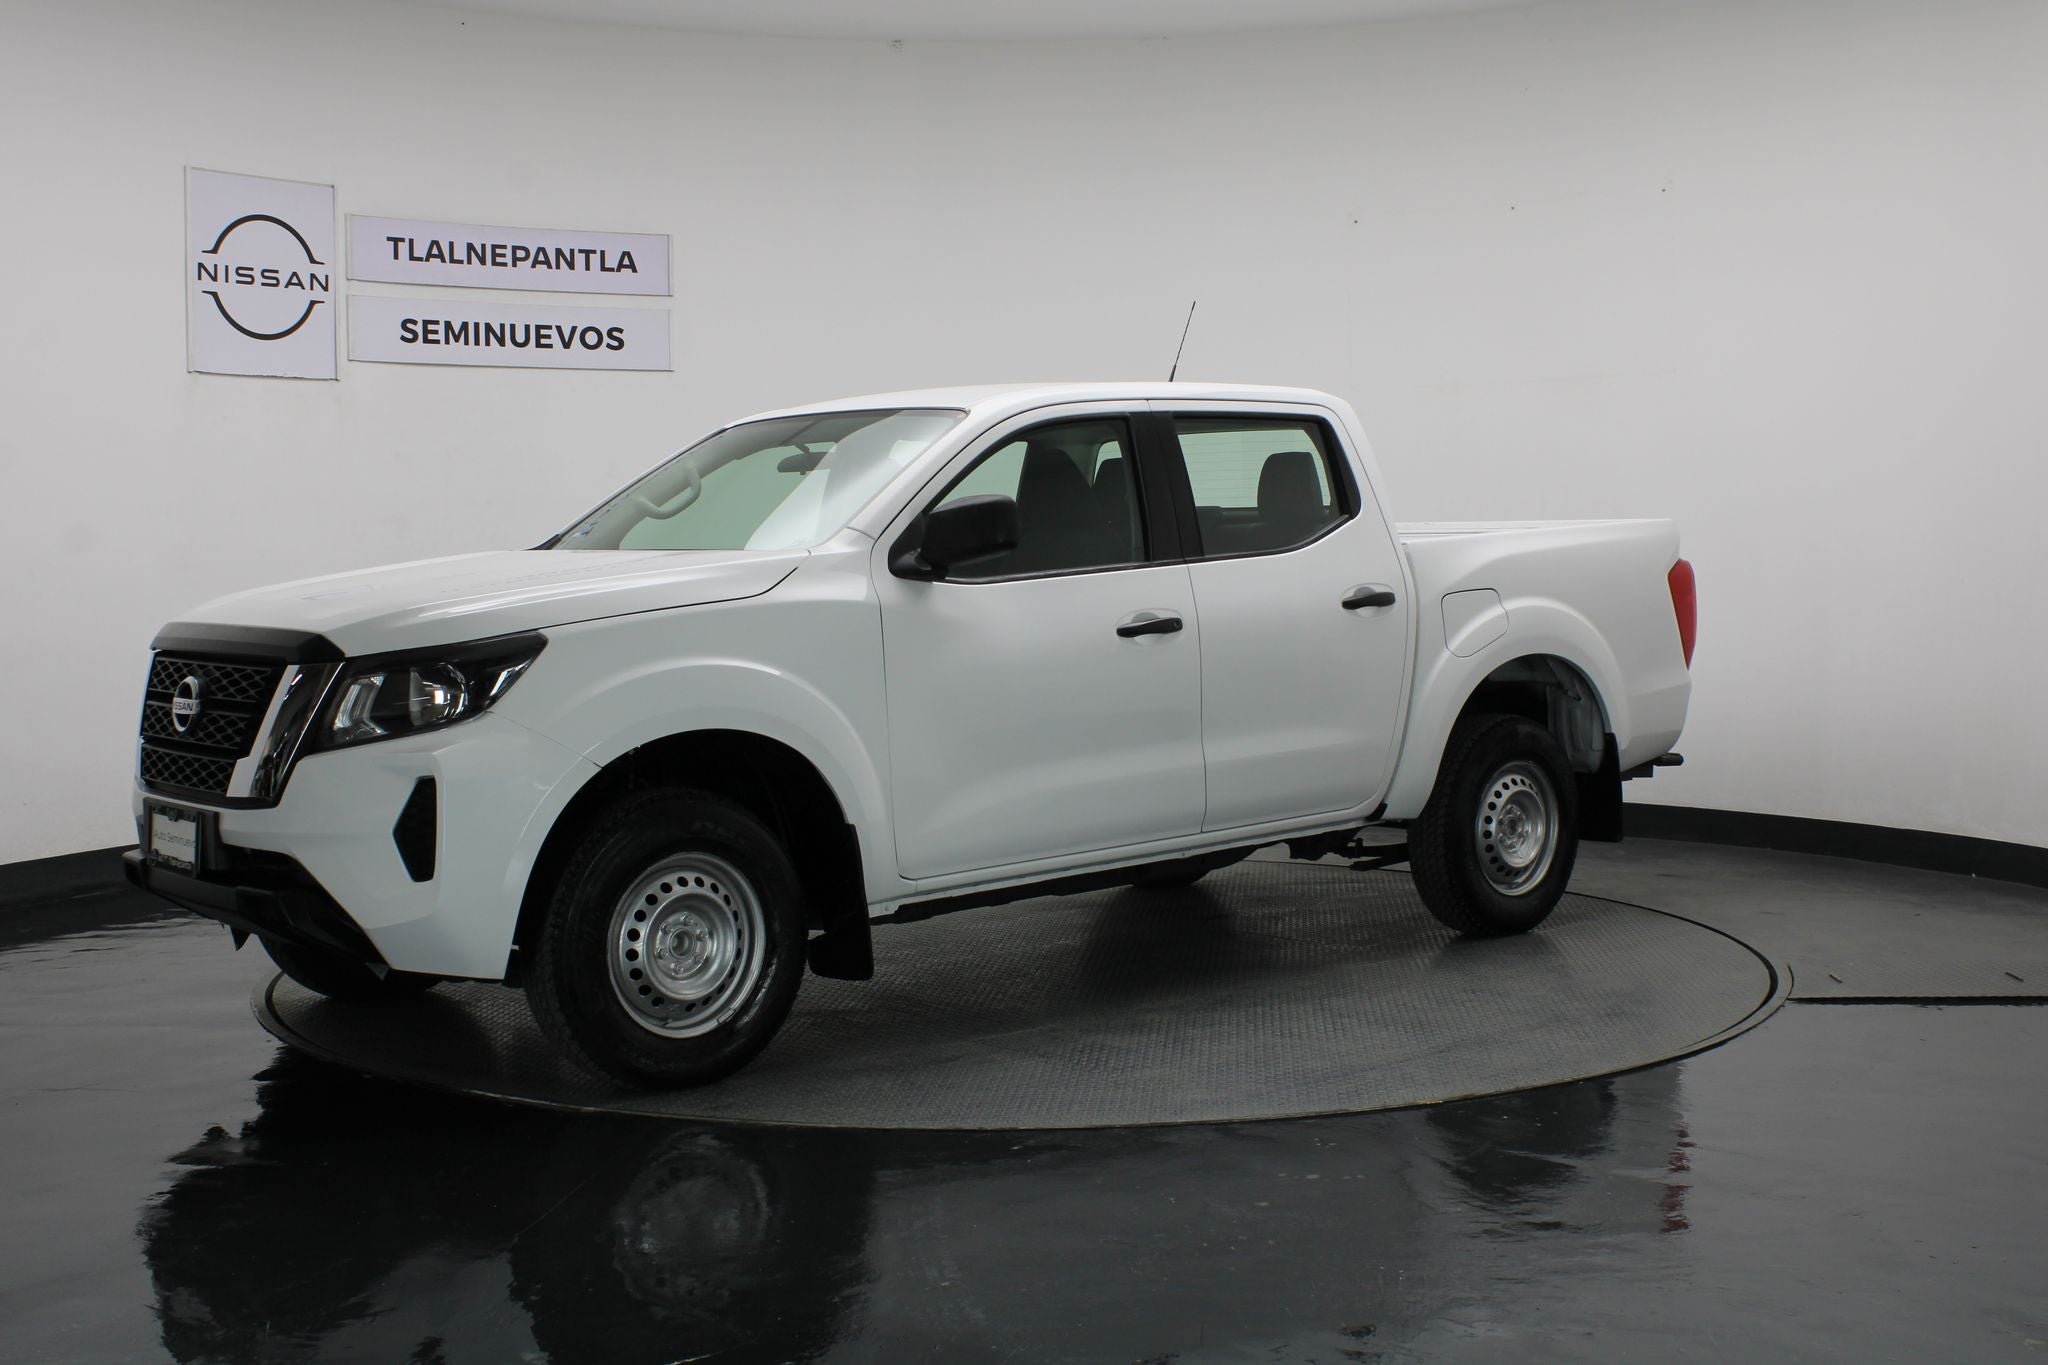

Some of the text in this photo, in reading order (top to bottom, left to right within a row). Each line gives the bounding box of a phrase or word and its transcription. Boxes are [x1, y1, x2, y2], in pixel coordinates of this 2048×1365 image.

[386, 236, 638, 275] TLALNEPANTLA
[197, 262, 330, 293] NISSAN
[399, 318, 626, 351] SEMINUEVOS
